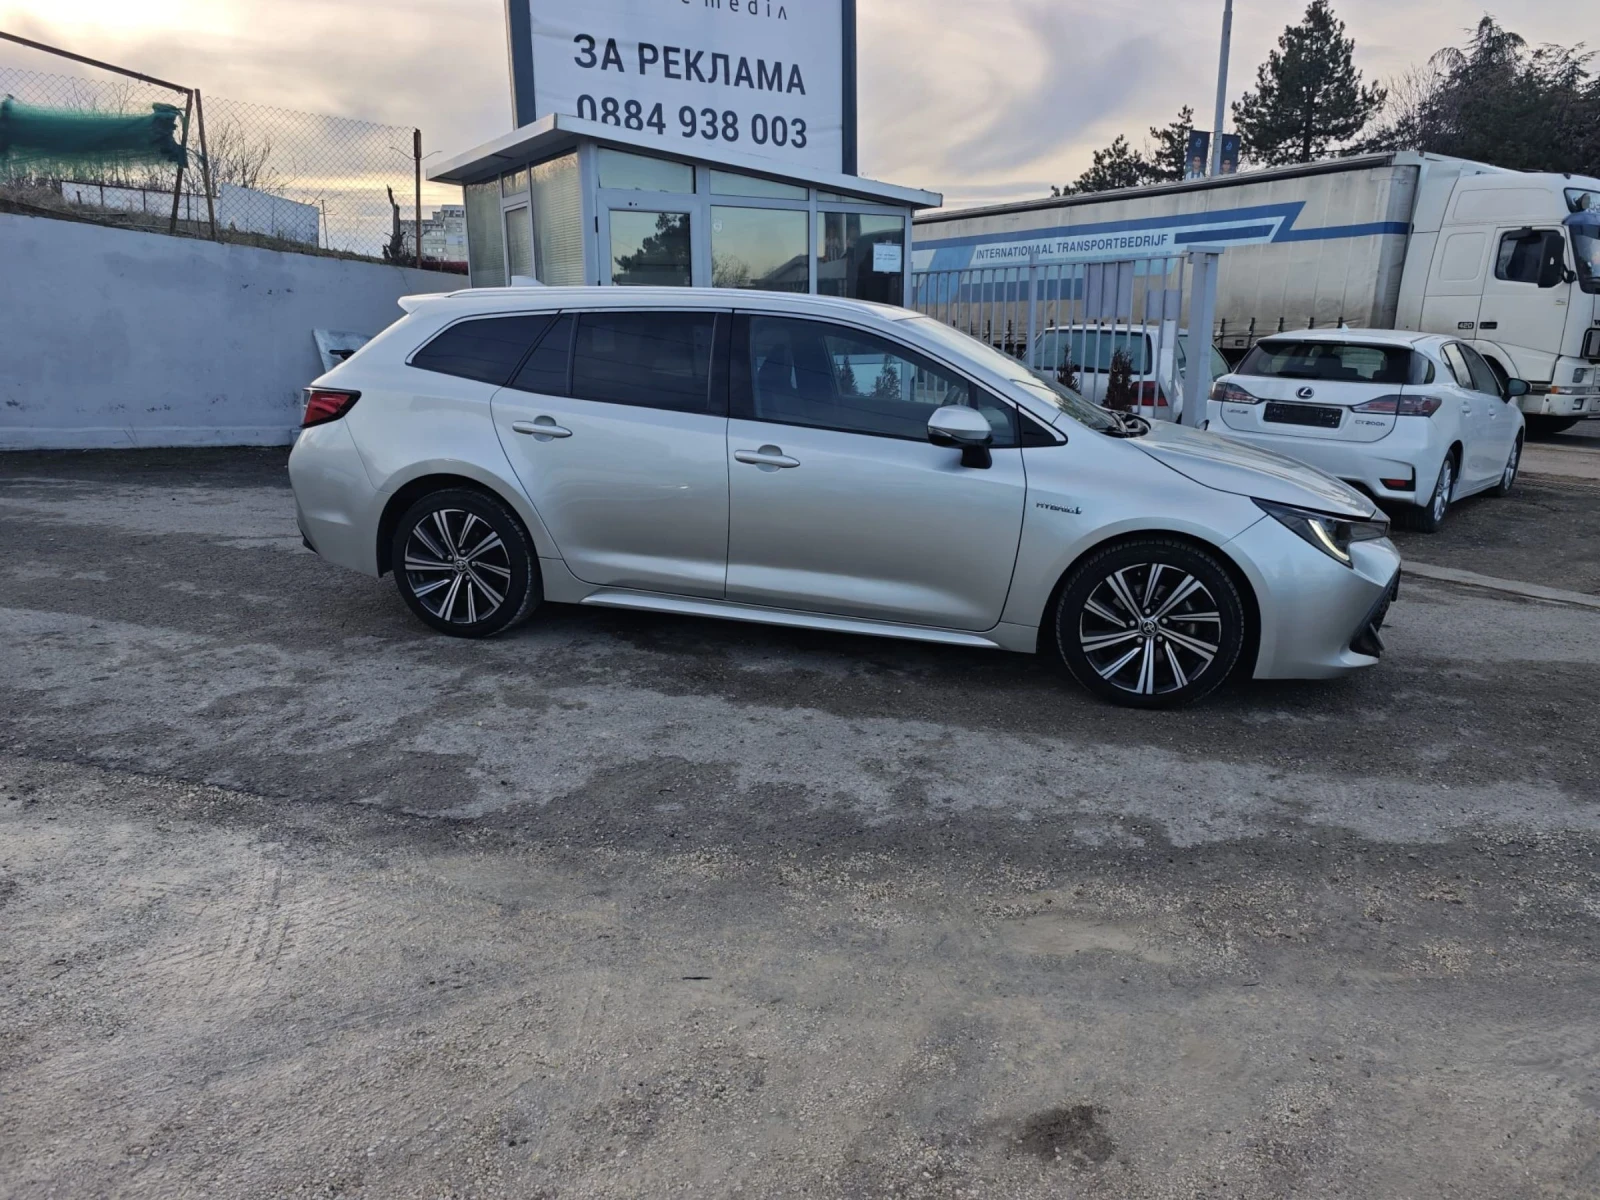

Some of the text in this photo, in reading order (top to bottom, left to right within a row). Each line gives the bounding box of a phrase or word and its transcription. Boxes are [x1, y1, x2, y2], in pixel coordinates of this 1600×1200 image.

[573, 33, 807, 95] ЗА РЕКЛАМА
[576, 94, 808, 149] 0884 938 003
[976, 233, 1169, 260] INTERNATIONAAL TRANSPORTBEDRIJF
